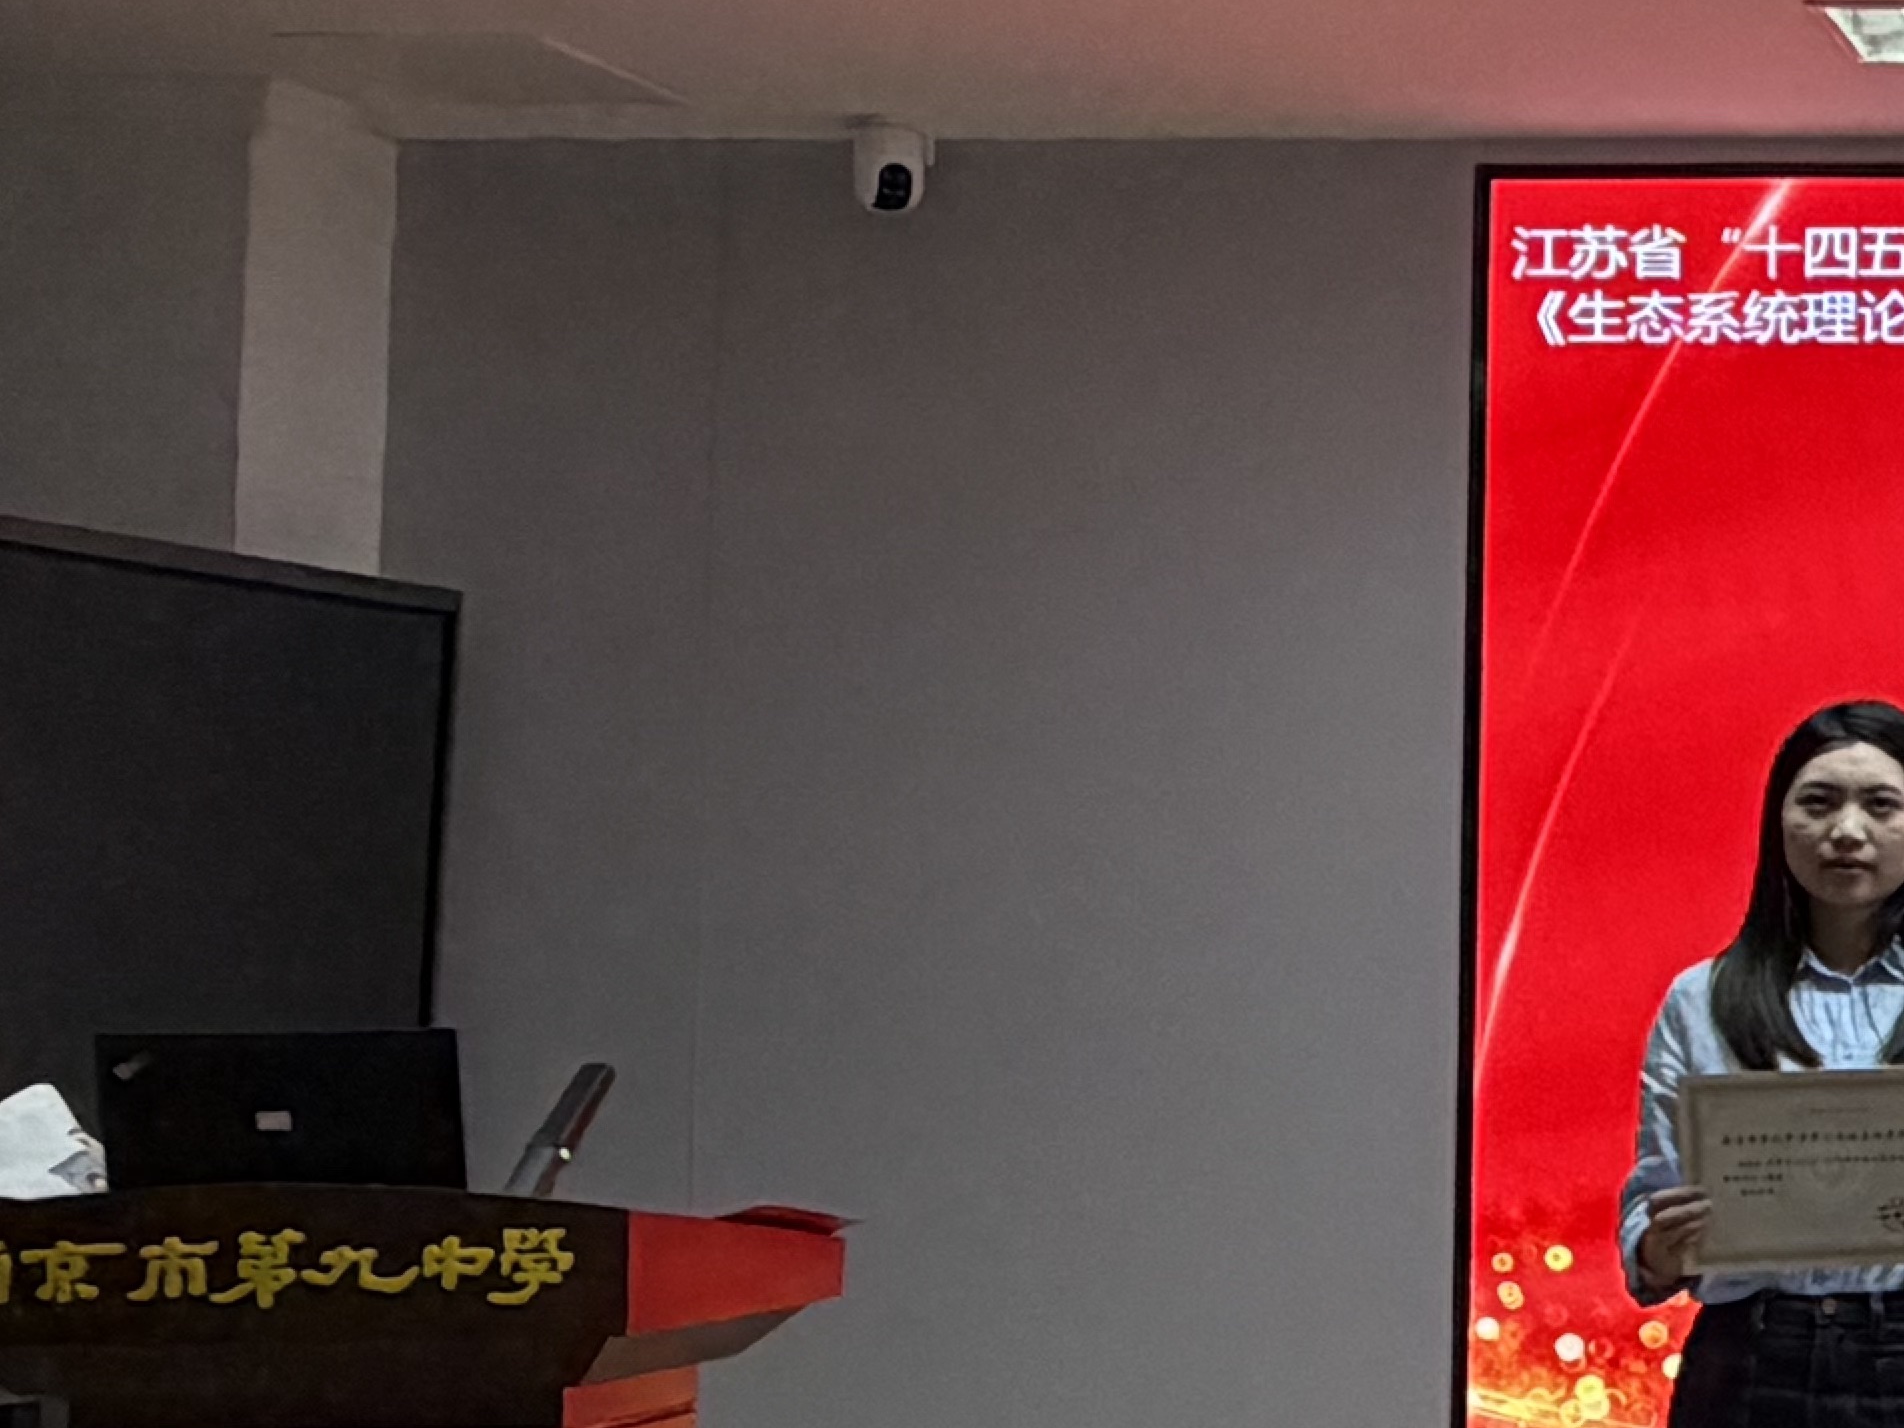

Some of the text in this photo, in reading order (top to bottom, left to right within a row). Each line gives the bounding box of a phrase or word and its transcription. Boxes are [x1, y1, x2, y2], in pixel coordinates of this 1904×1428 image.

[0, 1228, 576, 1309] 京市第九中學
